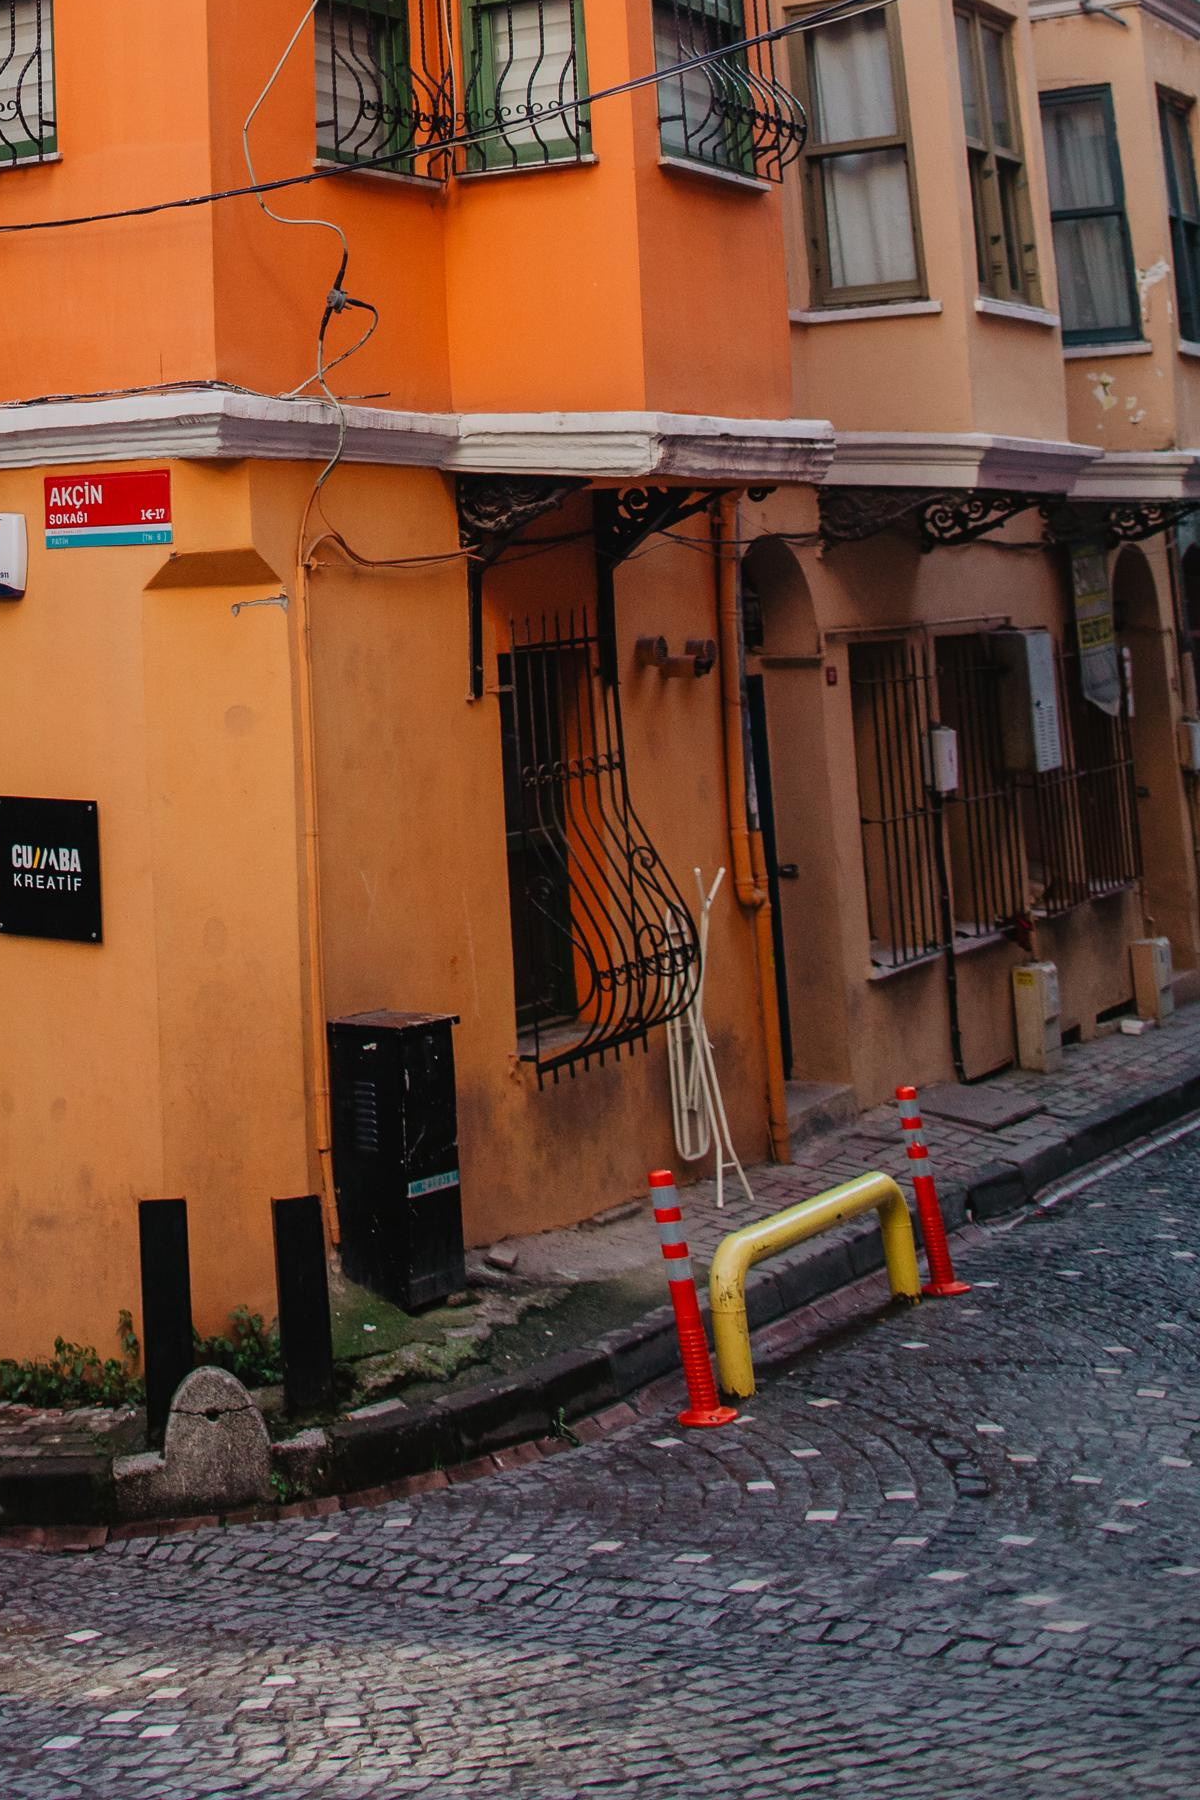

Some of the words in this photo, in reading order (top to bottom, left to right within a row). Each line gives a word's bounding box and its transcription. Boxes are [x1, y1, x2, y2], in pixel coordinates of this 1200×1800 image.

[49, 481, 103, 509] AKÇİN
[49, 511, 88, 525] SOKAĞI
[13, 873, 82, 892] KREATİF
